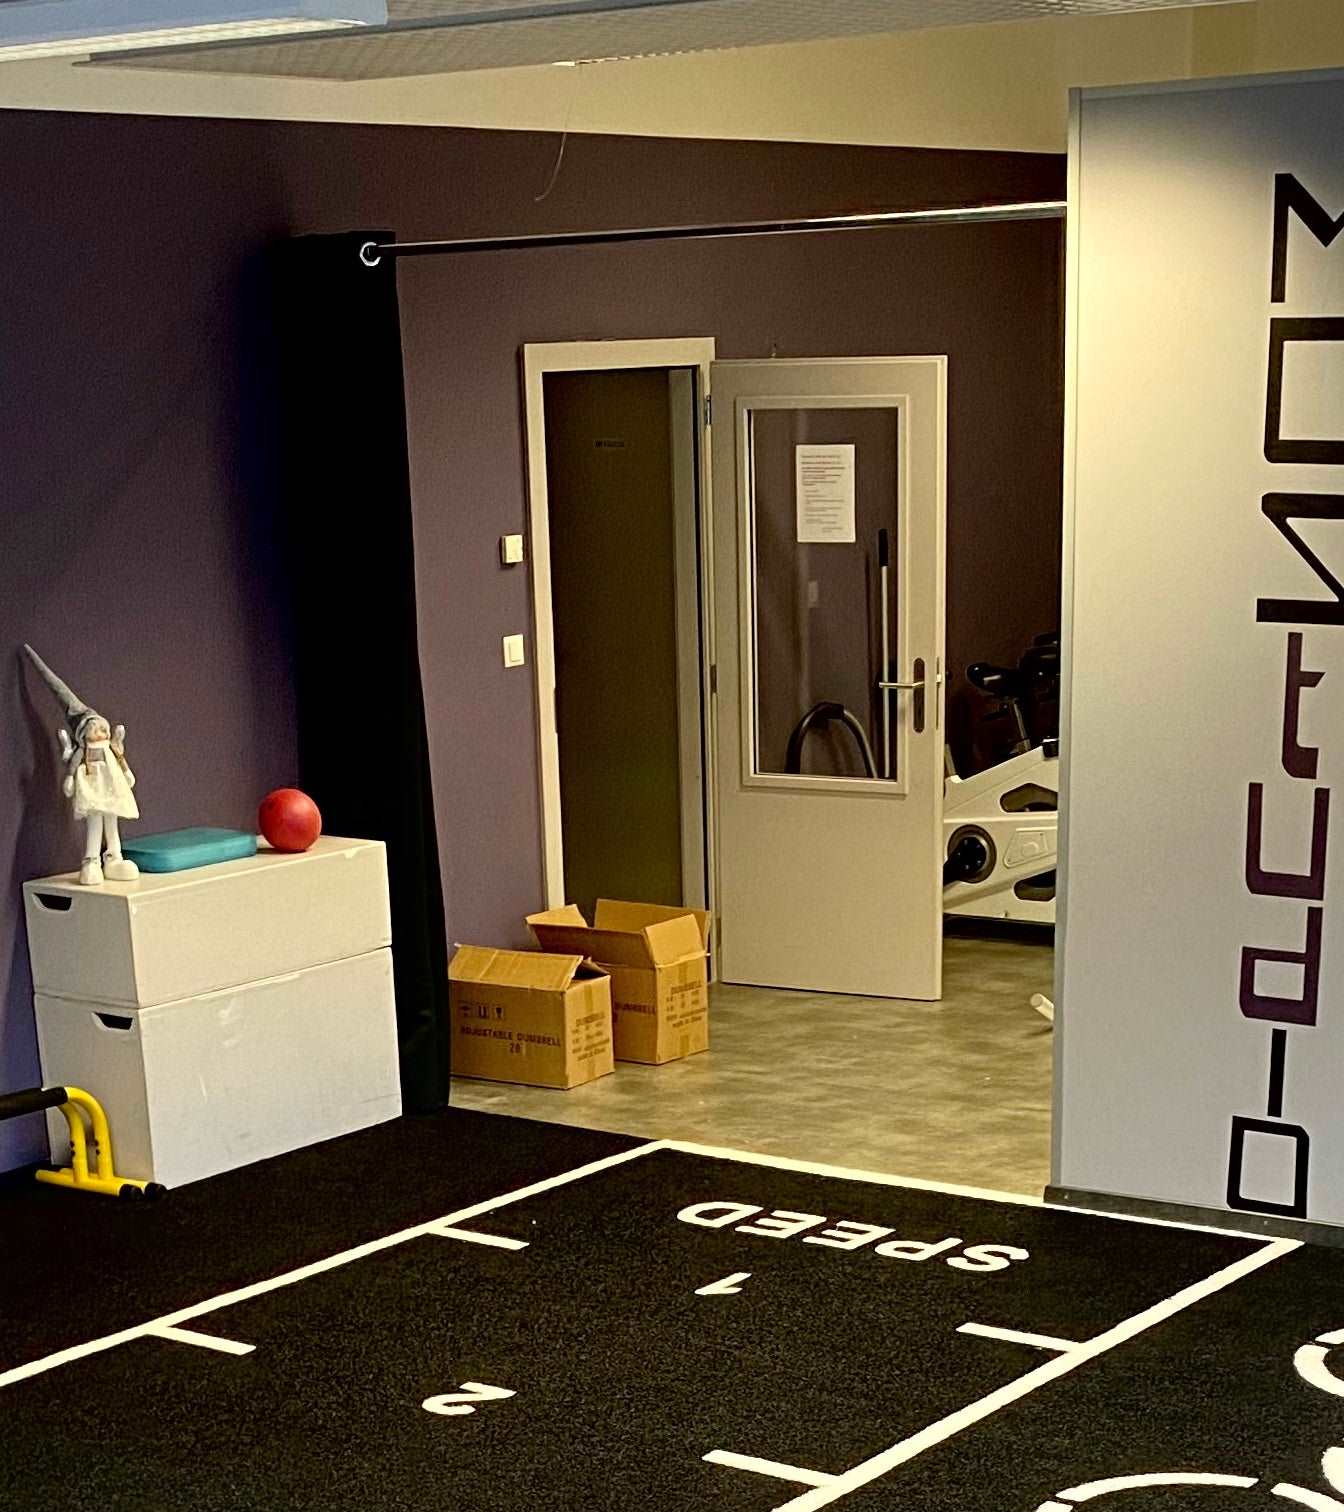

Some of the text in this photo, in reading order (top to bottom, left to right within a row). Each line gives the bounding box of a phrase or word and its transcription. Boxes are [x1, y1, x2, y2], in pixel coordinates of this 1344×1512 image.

[677, 1201, 1030, 1272] SPEED
[694, 1271, 752, 1296] 1
[421, 1381, 517, 1416] 2
